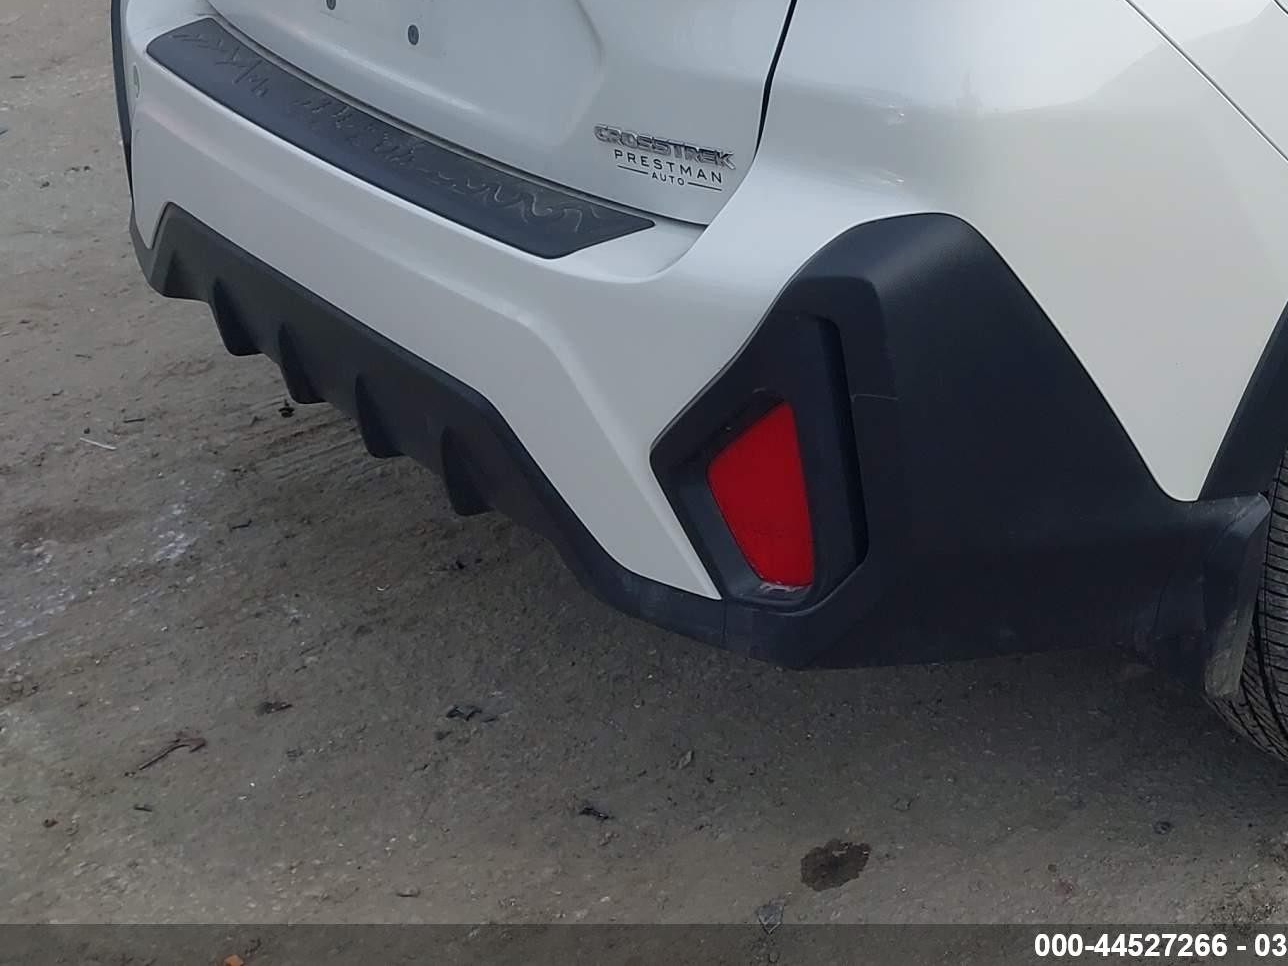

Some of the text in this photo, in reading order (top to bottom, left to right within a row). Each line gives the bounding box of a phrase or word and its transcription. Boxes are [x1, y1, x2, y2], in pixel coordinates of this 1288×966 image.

[594, 123, 736, 170] CROSSTREK
[614, 149, 722, 183] PRESTMAN
[651, 172, 685, 186] AUTO
